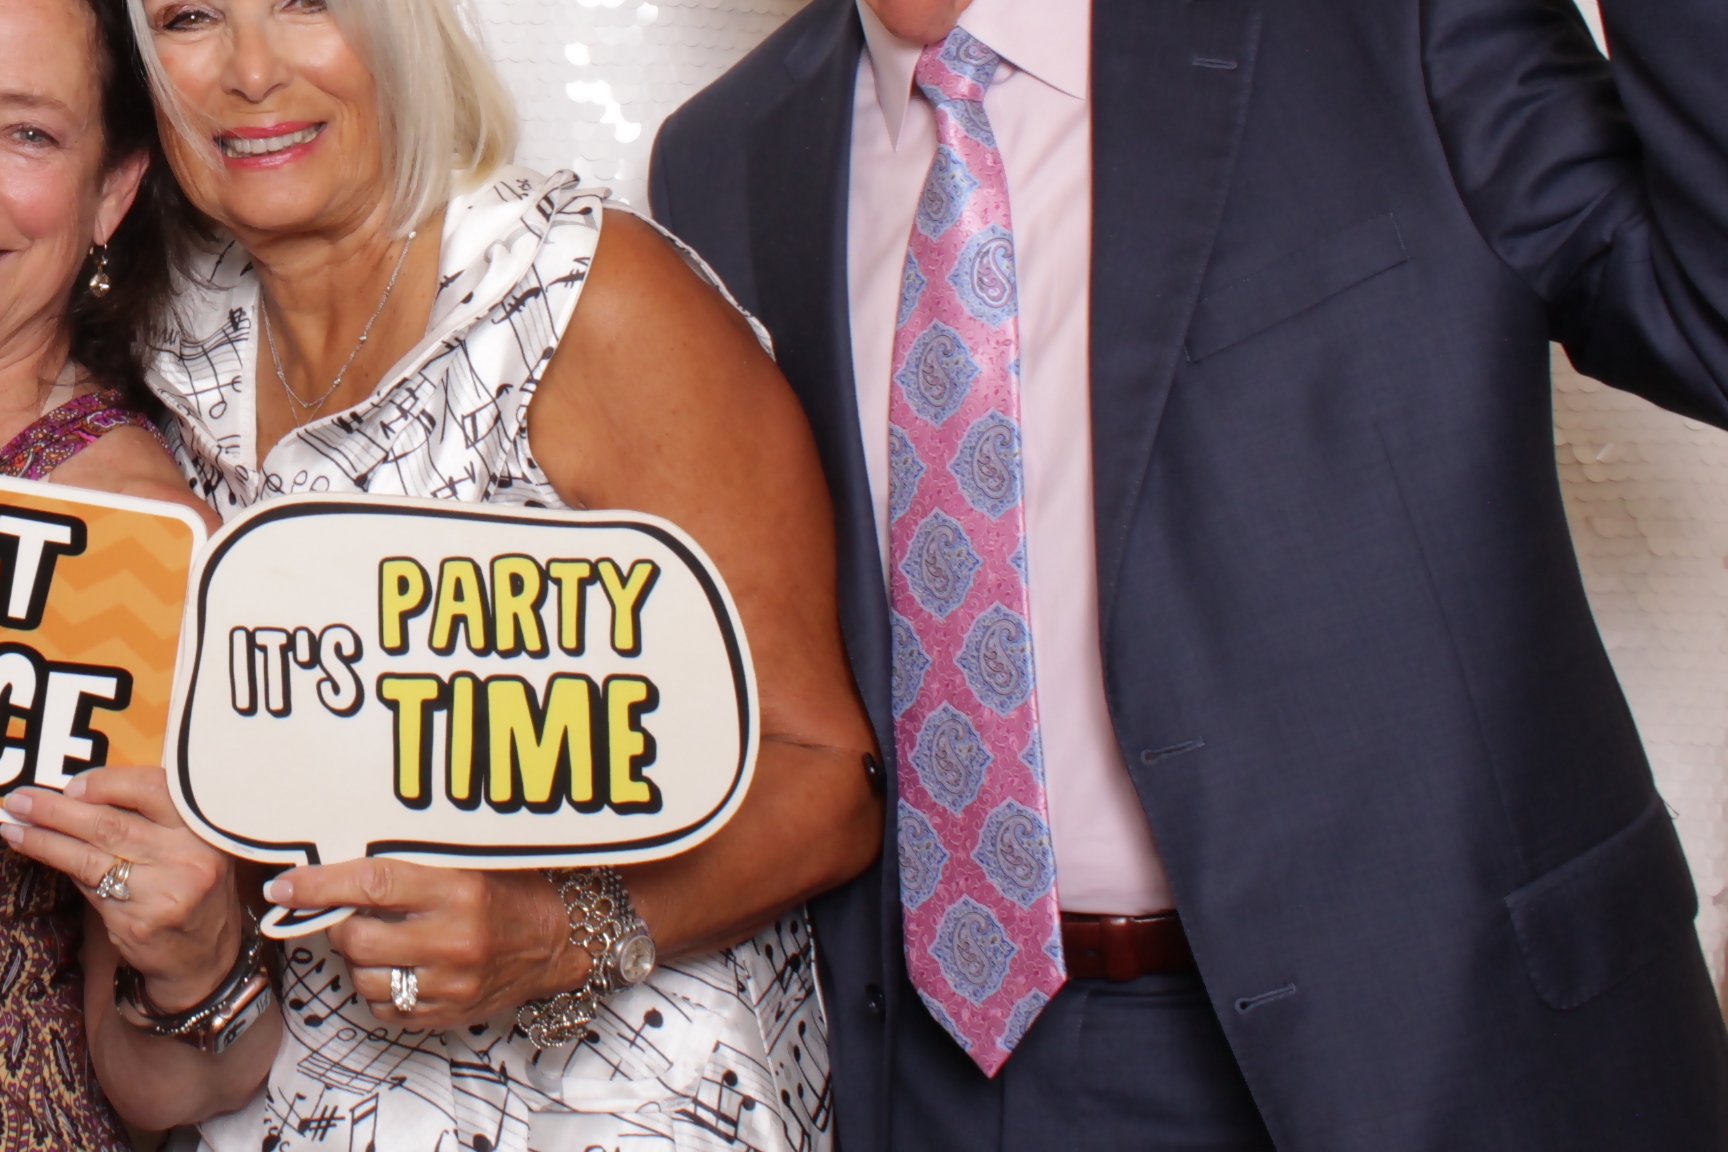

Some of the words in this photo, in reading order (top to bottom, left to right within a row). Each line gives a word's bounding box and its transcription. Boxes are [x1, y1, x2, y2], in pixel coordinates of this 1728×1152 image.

[378, 553, 661, 658] PARTY
[229, 623, 364, 718] IT'S
[377, 670, 663, 815] TIME
